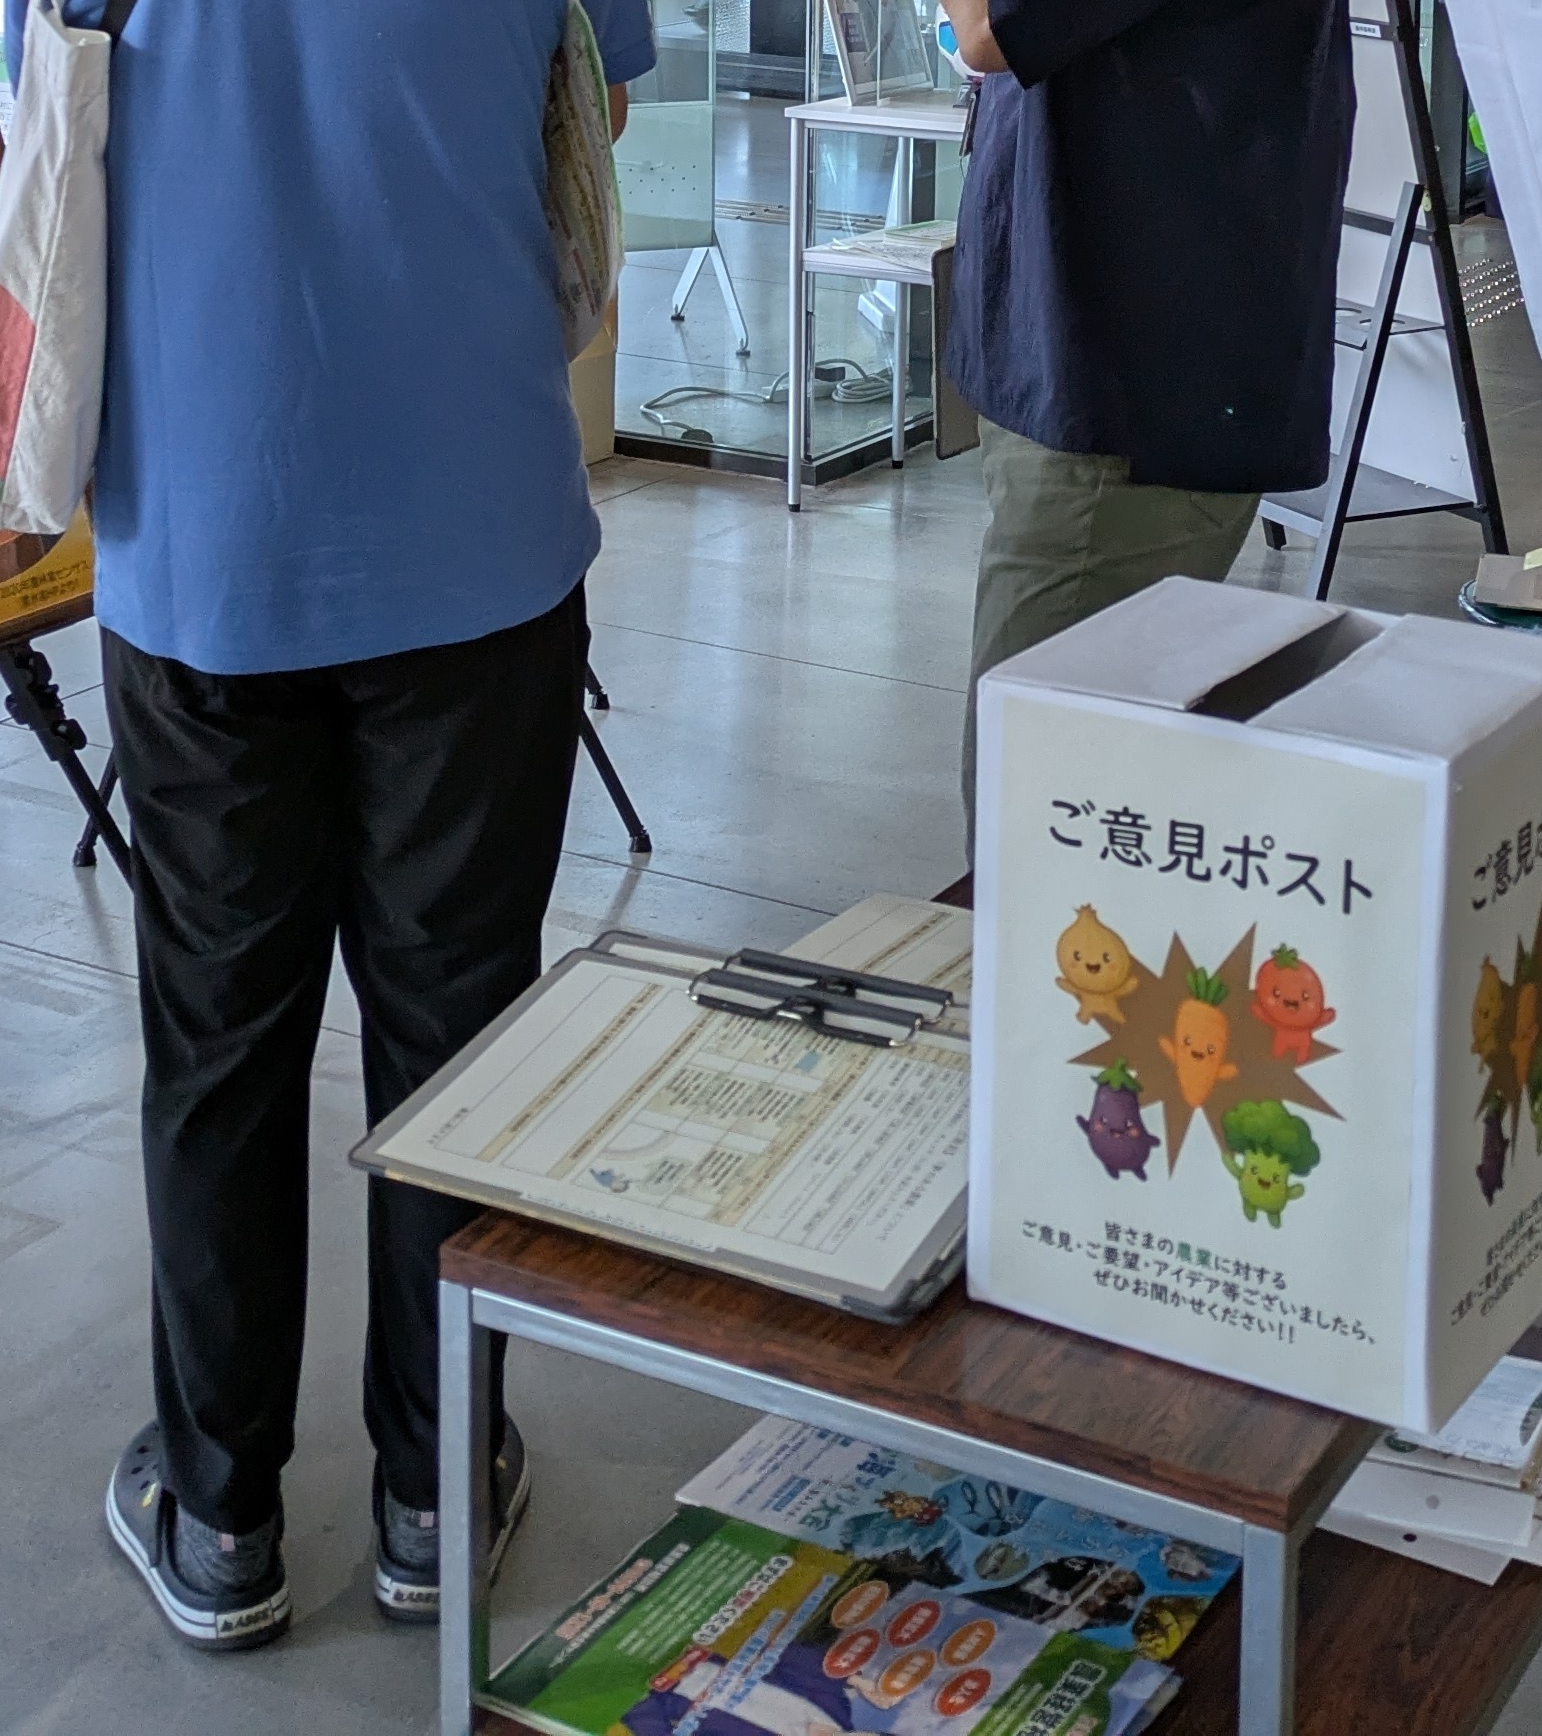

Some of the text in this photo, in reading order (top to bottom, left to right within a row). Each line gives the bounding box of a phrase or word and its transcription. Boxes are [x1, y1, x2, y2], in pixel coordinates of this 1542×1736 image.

[1049, 799, 1373, 916] ご意見ポスト
[1104, 1219, 1287, 1291] 皆さまの農業に対する
